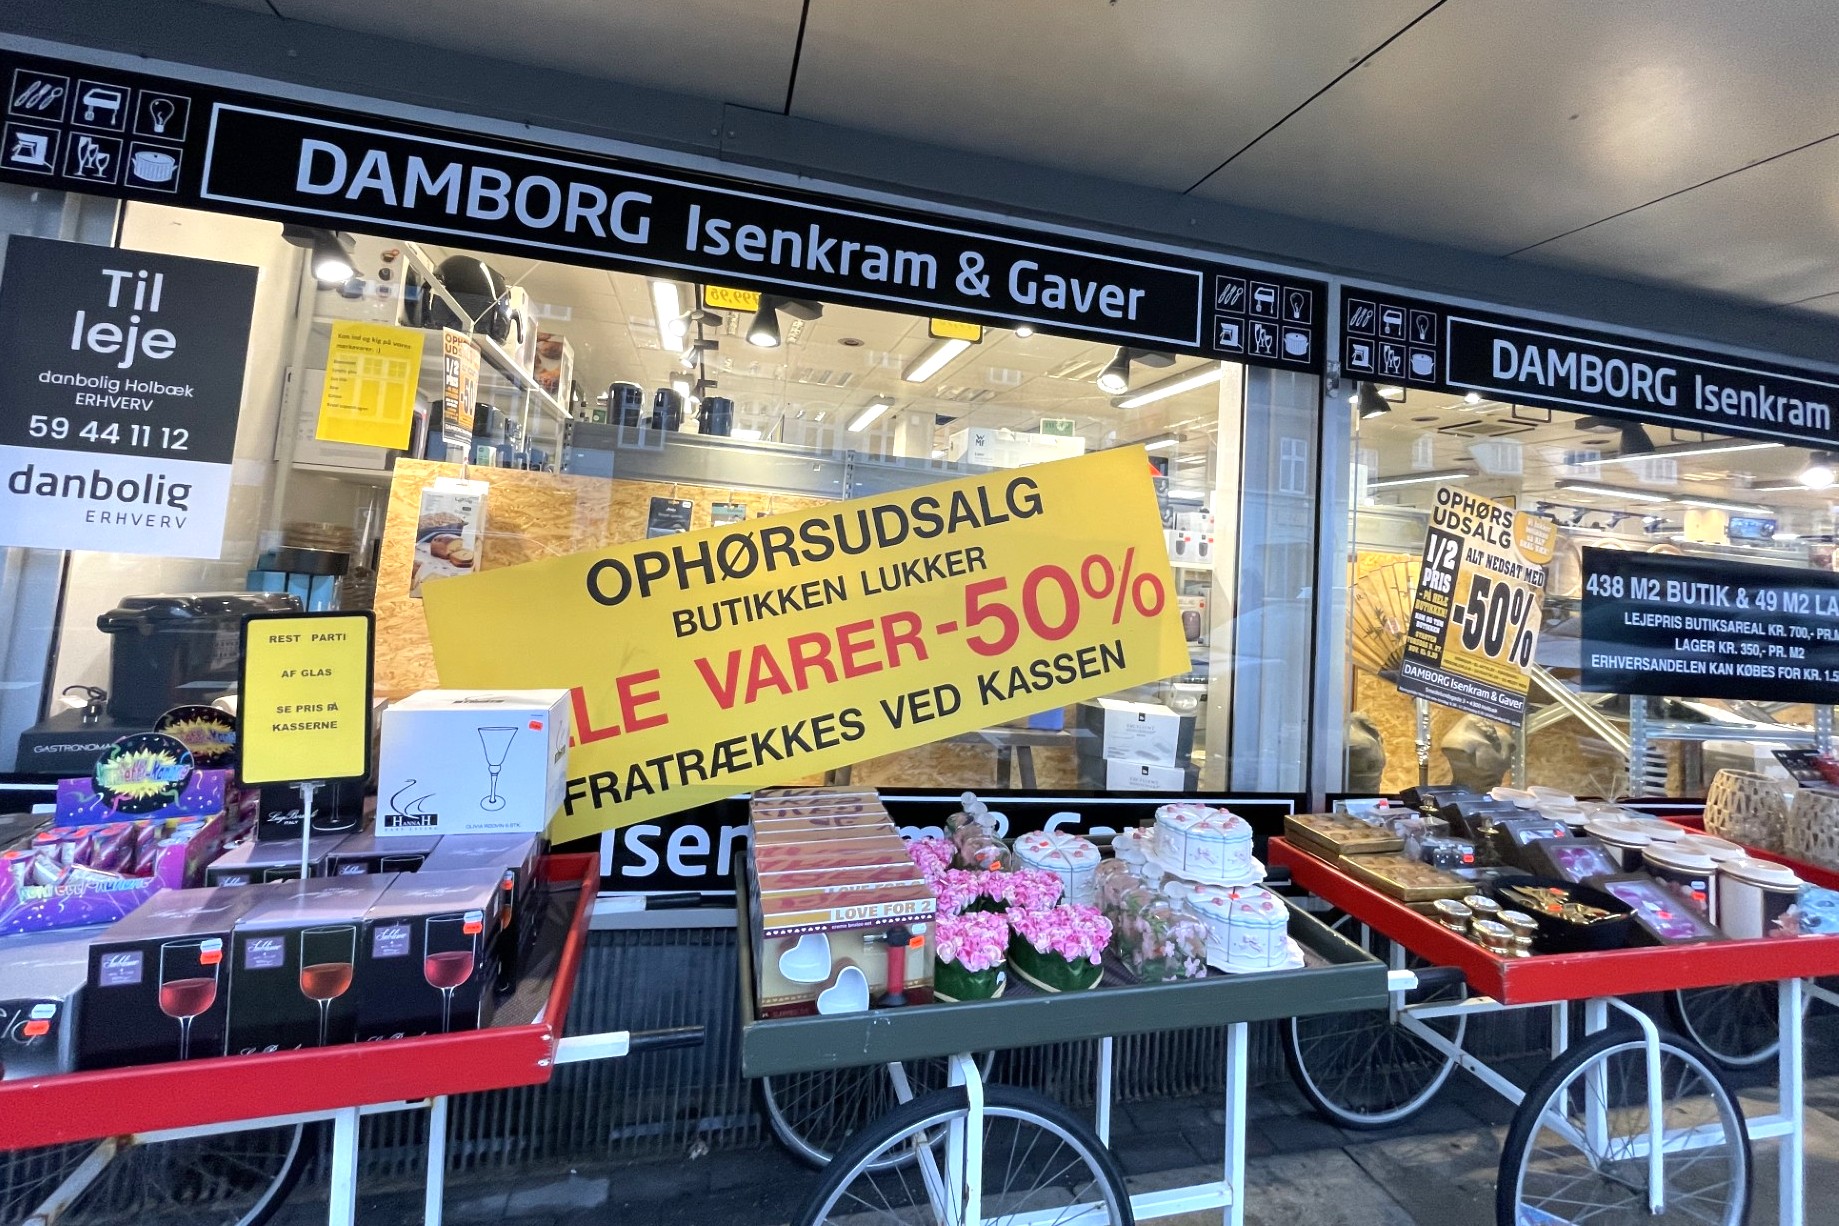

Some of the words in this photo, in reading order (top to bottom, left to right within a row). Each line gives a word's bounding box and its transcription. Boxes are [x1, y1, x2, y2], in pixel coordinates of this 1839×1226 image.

[296, 138, 651, 245] DAMBORG
[686, 203, 937, 291] Isenkram
[955, 250, 990, 299] &
[1008, 260, 1145, 321] Gaver
[102, 269, 163, 312] Til
[71, 310, 177, 369] leje
[38, 370, 120, 393] danbolig
[124, 378, 194, 398] Holbæk
[75, 393, 153, 411] ERHVERV
[1493, 338, 1677, 406] DAMBORG
[1695, 374, 1831, 431] Isenkram
[29, 415, 69, 439] 59
[79, 421, 120, 444] 44
[131, 424, 150, 447] 11
[162, 427, 189, 450] 12
[8, 464, 192, 511] danbolig
[85, 510, 187, 529] ERHVERV
[1433, 506, 1511, 549] UDSALG
[1437, 487, 1513, 529] OPHØRS
[586, 476, 1044, 607] OPHØRSUDSALG
[1426, 533, 1459, 571] 1/2
[1422, 568, 1452, 594] PRIS
[1466, 547, 1485, 566] ALT
[1485, 554, 1523, 579] NEDSAT
[1523, 567, 1546, 587] MED
[672, 575, 848, 638] BUTIKKEN
[861, 546, 988, 596] LUKKER
[1586, 573, 1625, 598] 438
[1630, 577, 1660, 602] M2
[1666, 580, 1730, 607] BUTIK
[1735, 587, 1749, 609] &
[1755, 590, 1778, 612] 49
[1783, 591, 1810, 614] M2
[269, 633, 301, 643] REST
[311, 632, 347, 642] PARTI
[1452, 573, 1534, 668] -50%
[1624, 612, 1682, 629] LEJEPRIS
[1685, 617, 1765, 636] BUTIKSAREAL
[1768, 624, 1787, 637] KR.
[1789, 625, 1815, 640] 700,-
[1592, 654, 1706, 674] ERHVERSANDELEN
[1709, 661, 1733, 675] KAN
[1736, 663, 1775, 678] KØBES
[1778, 666, 1801, 680] FOR
[1803, 668, 1822, 681] KR.
[1675, 638, 1715, 654] LAGER
[1718, 641, 1738, 655] KR.
[1740, 643, 1766, 658] 350,-
[1768, 645, 1787, 658] PR.
[1789, 646, 1805, 659] M2
[281, 669, 296, 678] AF
[301, 668, 332, 677] GLAS
[1404, 664, 1450, 687] DAMBORG
[1450, 678, 1490, 700] Isenkram
[1490, 691, 1498, 702] &
[1498, 694, 1524, 710] Gaver
[272, 721, 338, 732] KASSERNE
[276, 705, 291, 714] SE
[296, 704, 323, 713] PRIS
[563, 707, 866, 817] FRATRÆKKES
[880, 683, 962, 730] VED
[977, 639, 1127, 706] KASSEN
[568, 669, 669, 748] LE
[835, 905, 877, 921] LOVE
[883, 902, 915, 916] FOR
[921, 901, 931, 912] 2
